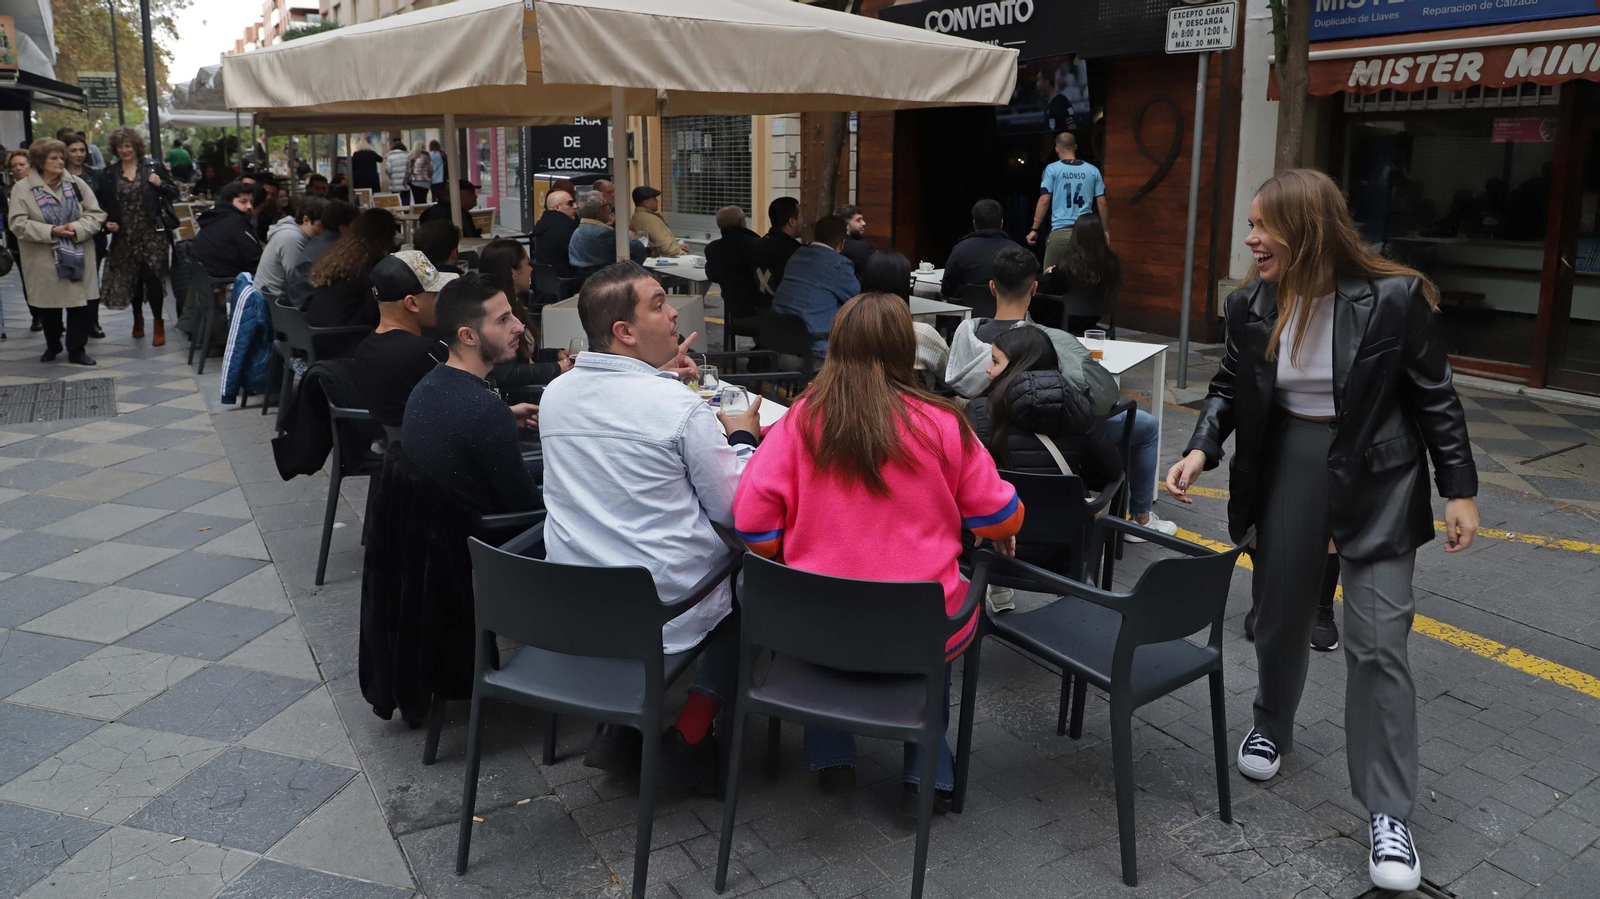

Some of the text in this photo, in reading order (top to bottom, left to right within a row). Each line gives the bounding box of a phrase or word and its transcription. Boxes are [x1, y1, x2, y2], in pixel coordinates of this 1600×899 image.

[1173, 7, 1229, 19] EXCEPTO CARGA
[1422, 3, 1477, 17] Reparacion
[1480, 2, 1493, 10] de
[925, 0, 1034, 33] CONVENTO
[1178, 17, 1223, 28] Y DESCARGA
[1314, 12, 1400, 28] Duplicado de Llaves
[1181, 29, 1194, 38] 8:00
[1203, 26, 1220, 36] 12:00
[1195, 39, 1203, 47] 30
[1206, 38, 1223, 46] MIN.
[1348, 52, 1484, 87] MISTER
[563, 136, 581, 148] DE
[1062, 172, 1086, 180] ALONSO
[1063, 182, 1085, 209] 14
